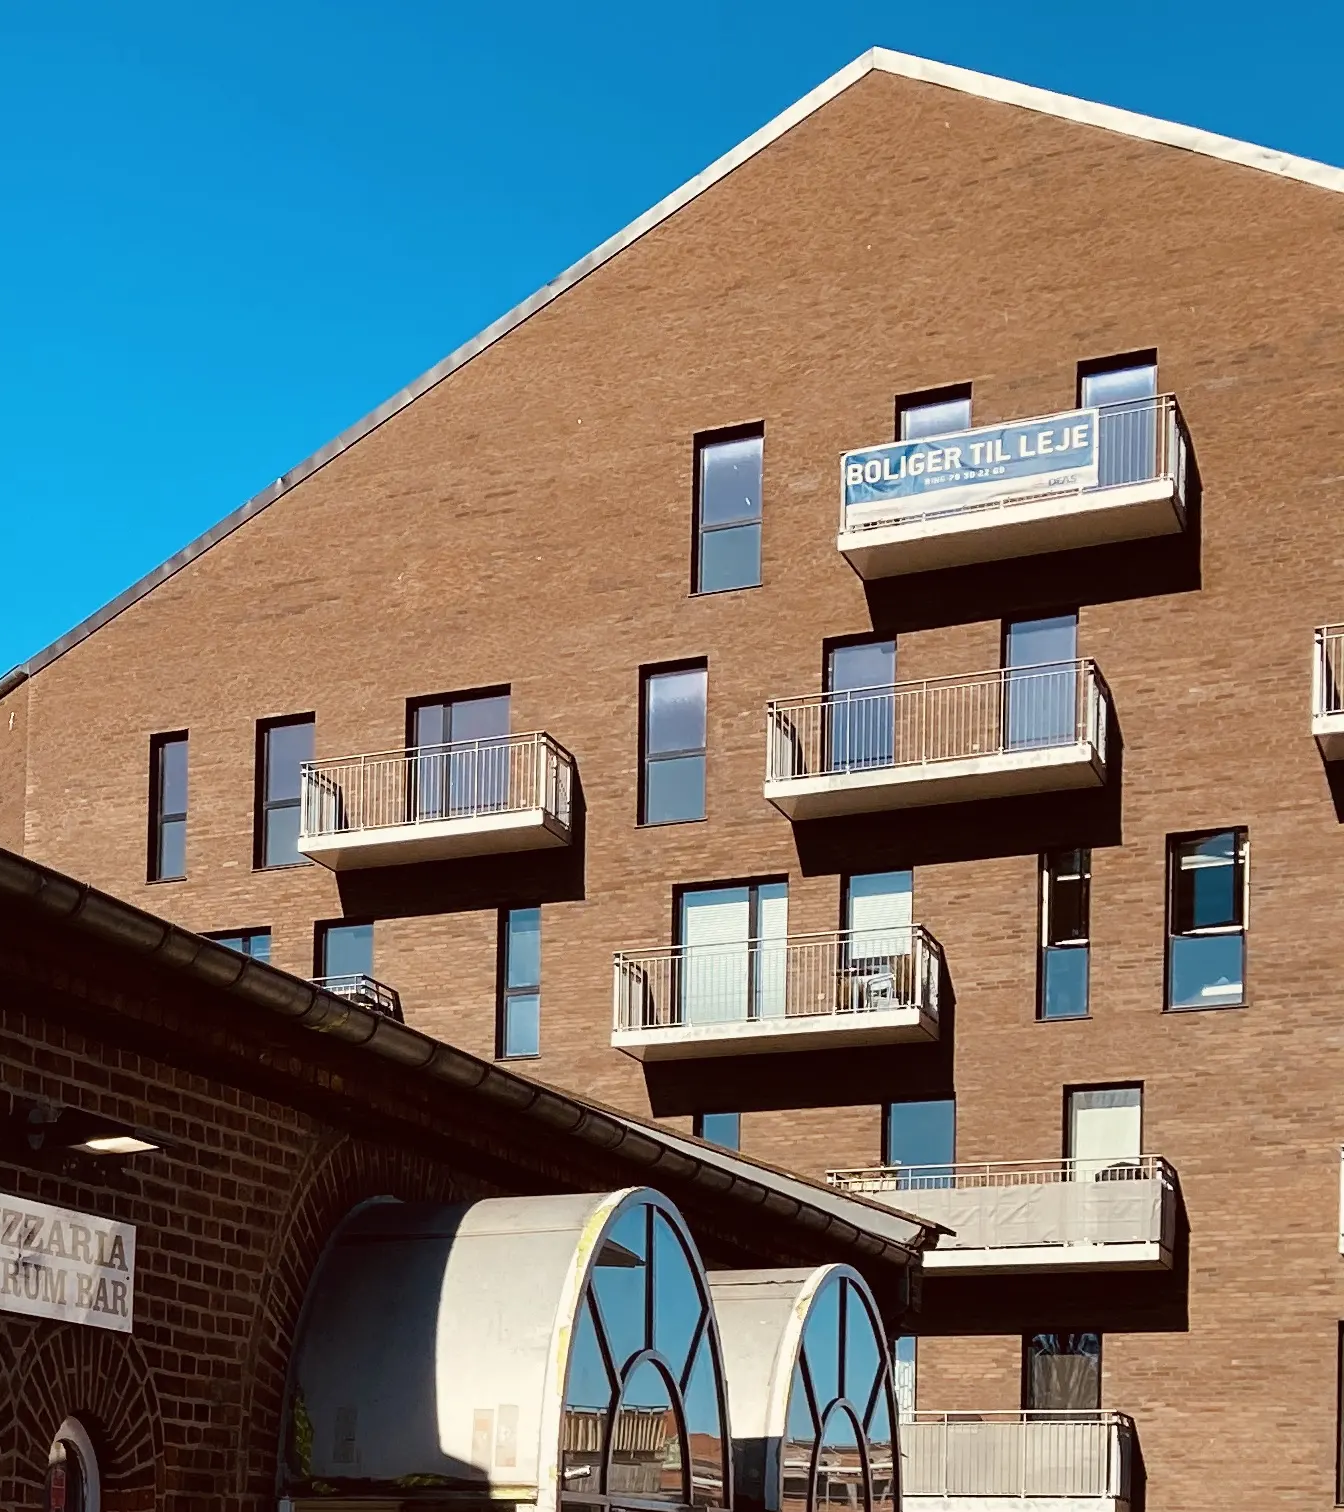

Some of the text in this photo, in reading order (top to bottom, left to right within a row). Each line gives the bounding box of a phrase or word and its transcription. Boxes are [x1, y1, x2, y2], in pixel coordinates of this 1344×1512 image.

[847, 424, 1089, 486] BOLIGER TIL LEJE
[75, 1272, 128, 1318] BAR
